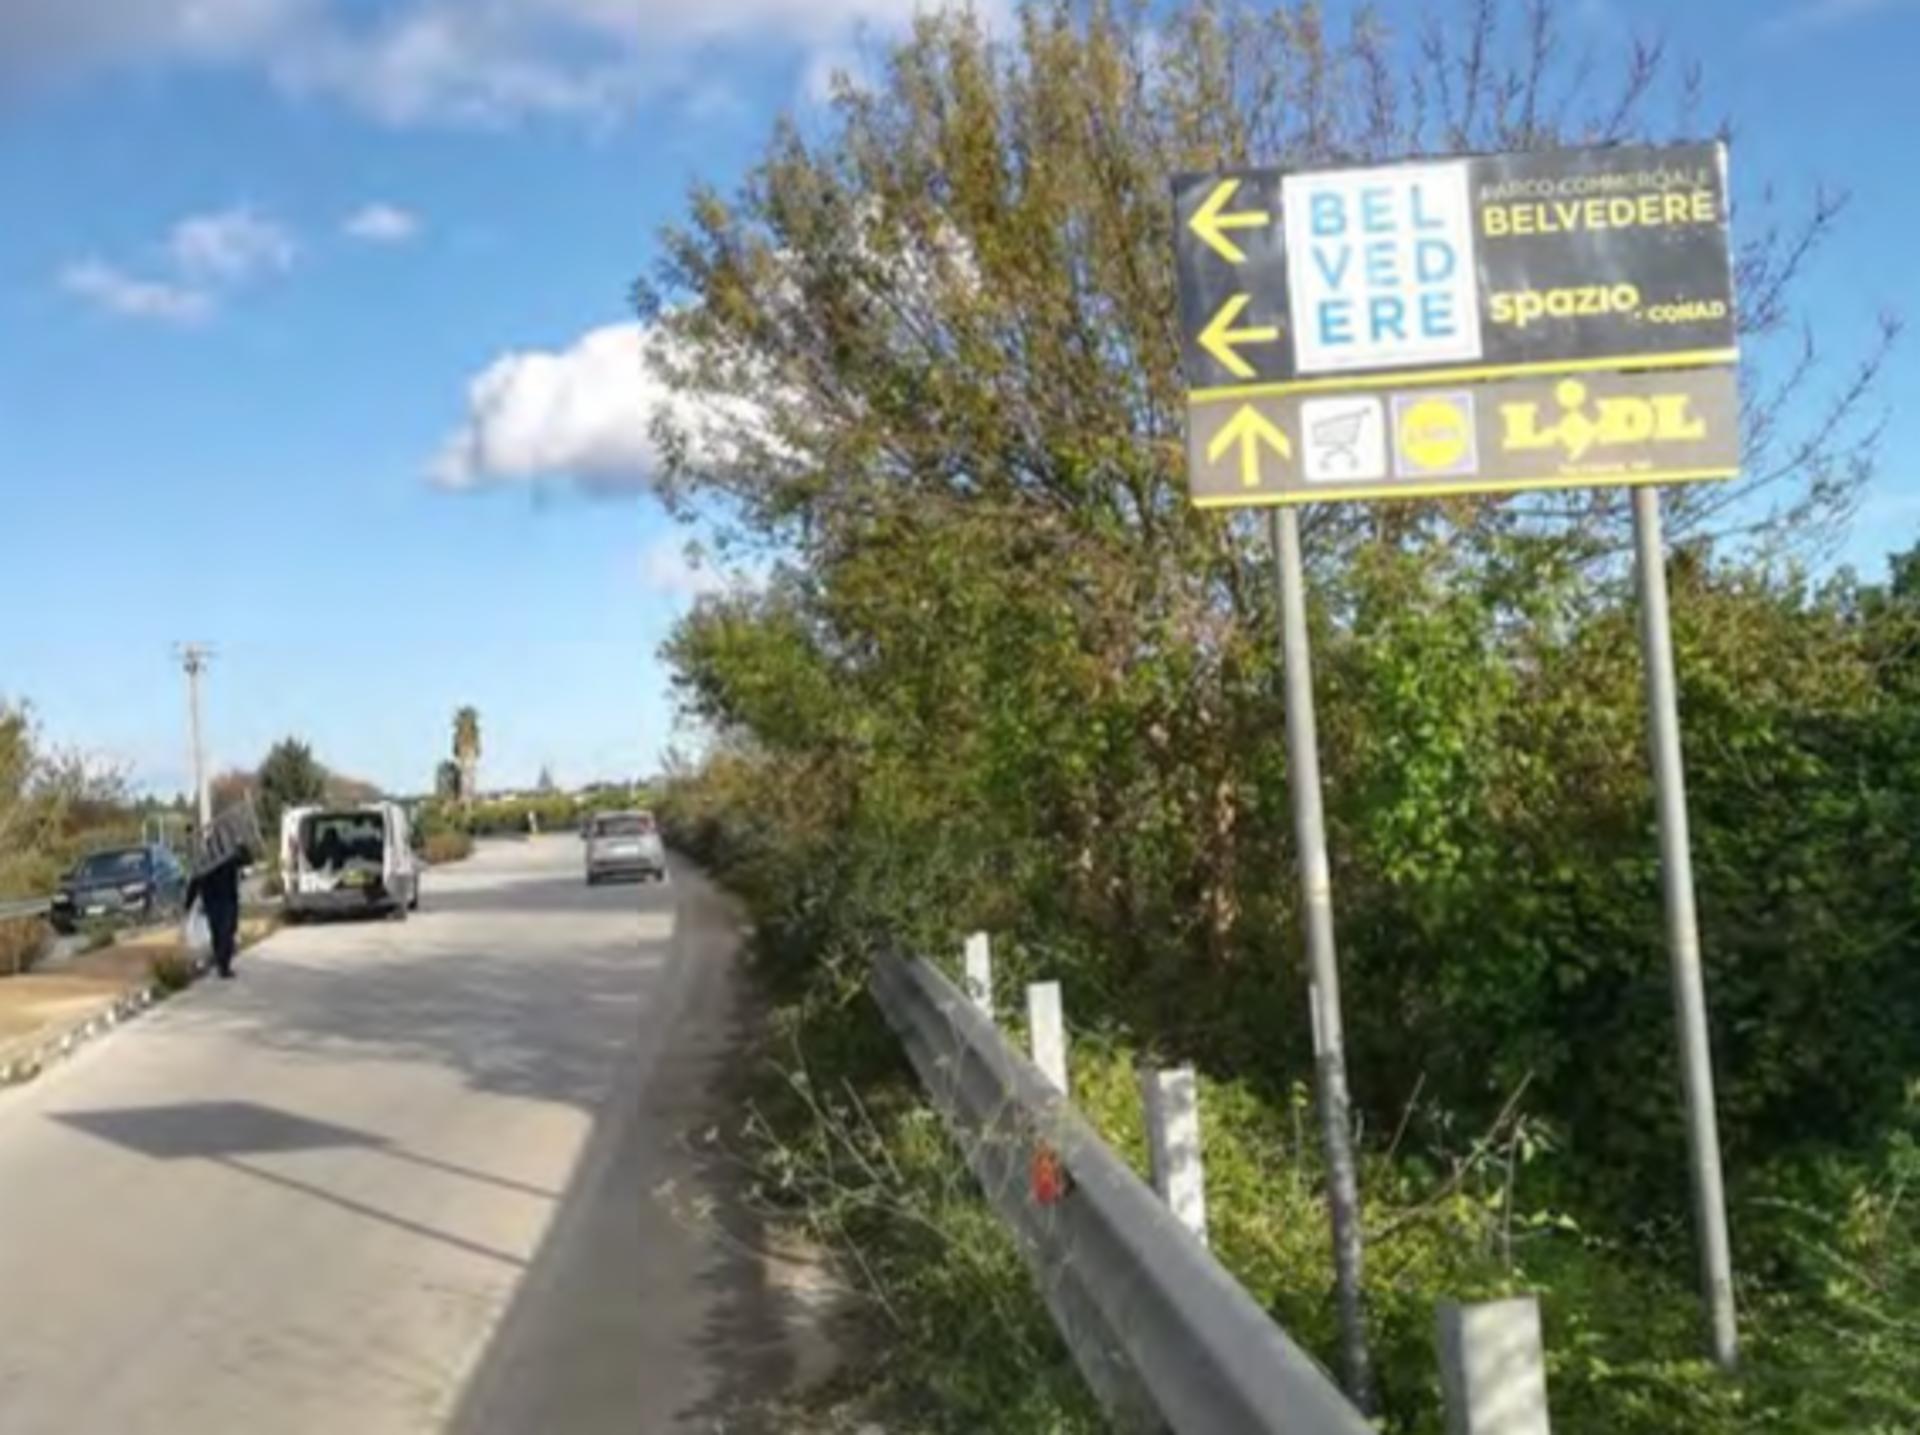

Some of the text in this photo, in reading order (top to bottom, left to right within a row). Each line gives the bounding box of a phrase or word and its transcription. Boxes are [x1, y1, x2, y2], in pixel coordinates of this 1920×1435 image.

[1310, 184, 1445, 237] BEL
[1482, 190, 1715, 237] BELVEDERE
[1312, 239, 1457, 290] VED
[1319, 293, 1457, 347] ERE
[1648, 301, 1726, 322] CONAD
